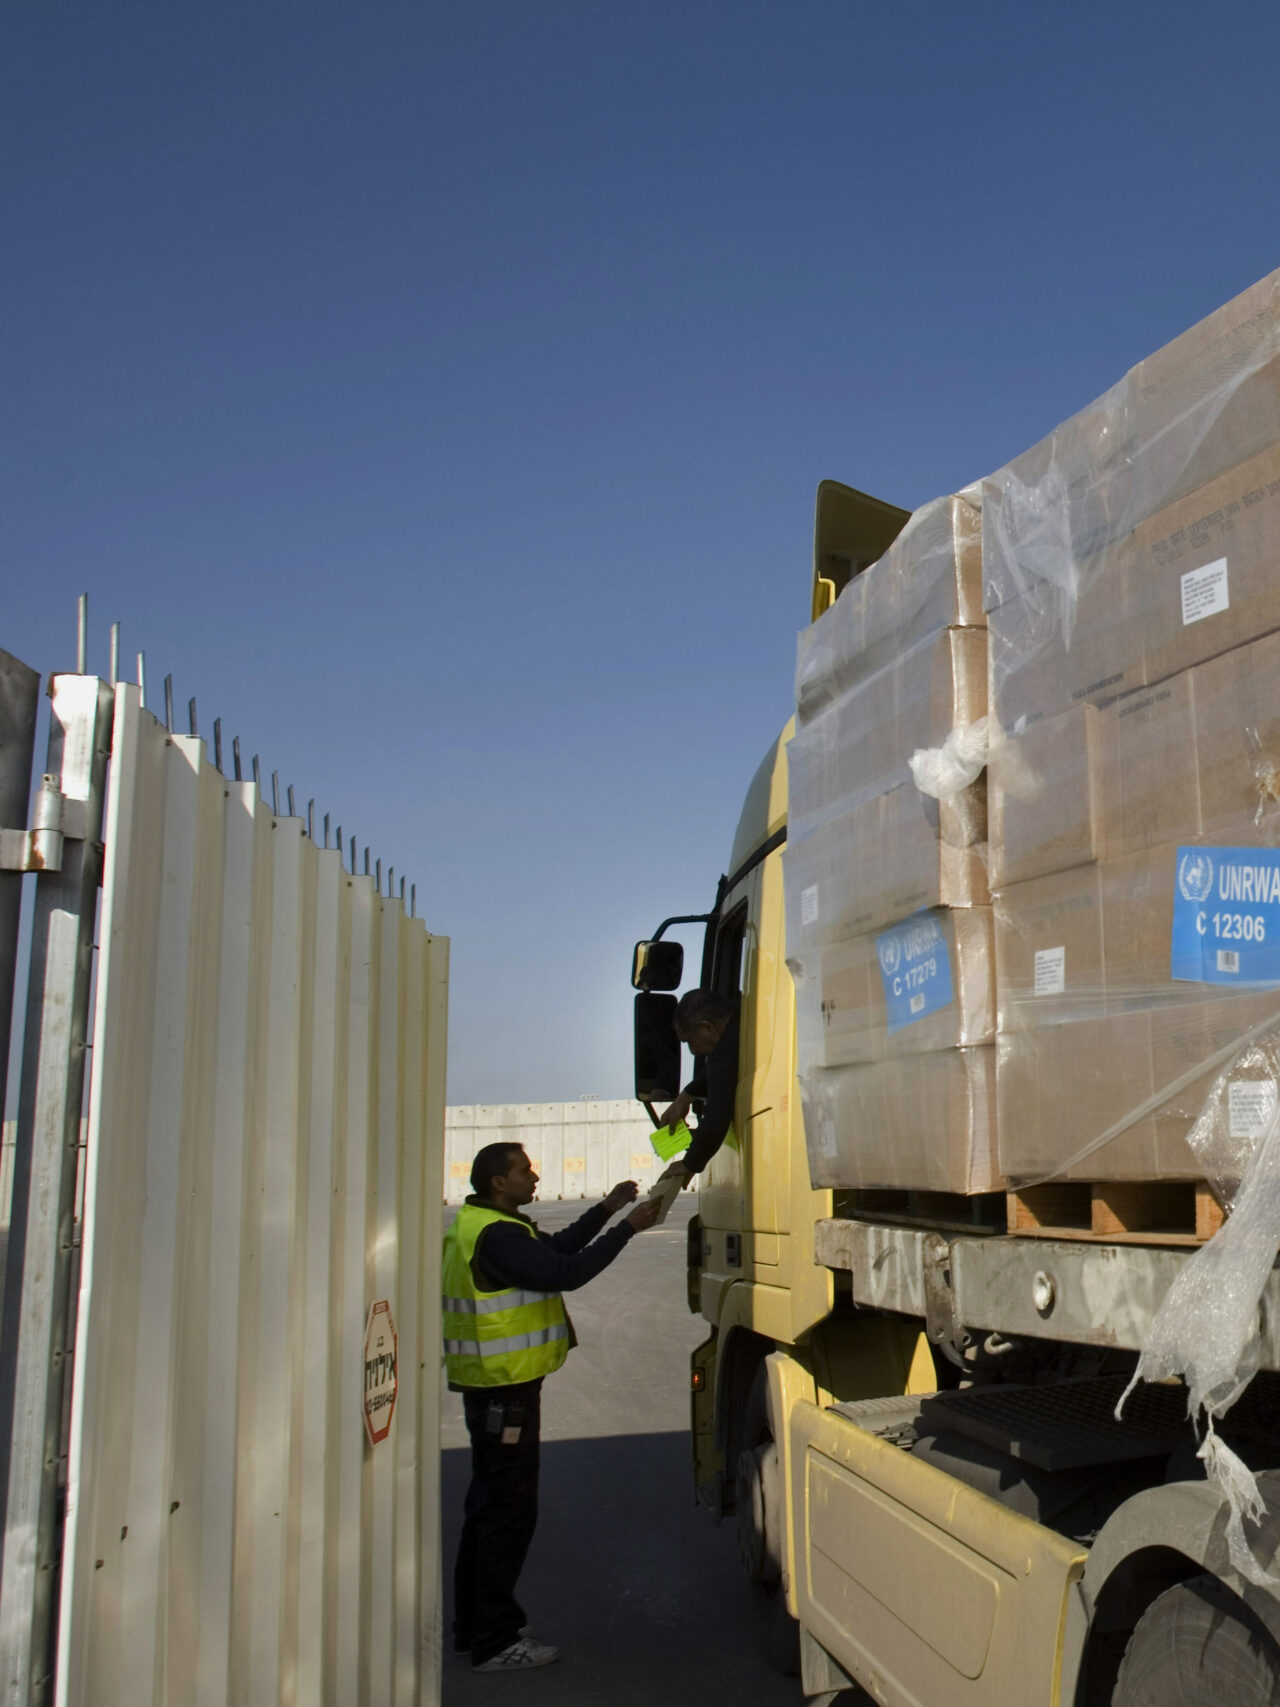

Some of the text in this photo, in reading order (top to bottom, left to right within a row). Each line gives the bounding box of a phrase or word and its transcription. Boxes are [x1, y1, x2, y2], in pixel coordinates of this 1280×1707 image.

[1196, 911, 1265, 942] C 12306
[893, 958, 937, 996] C 17279
